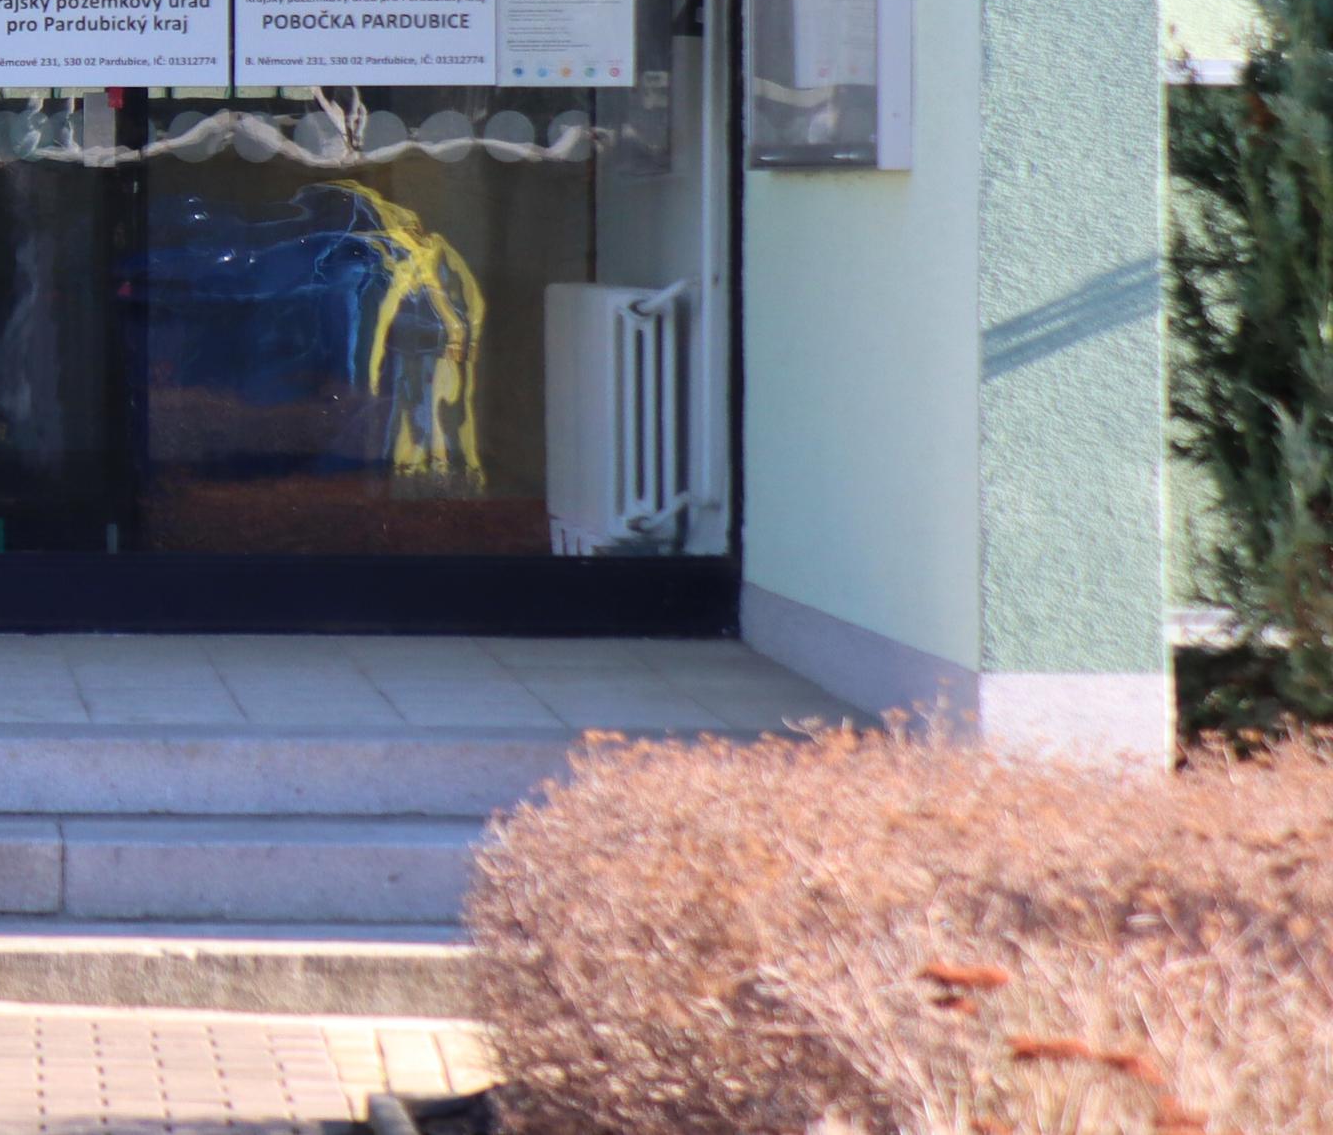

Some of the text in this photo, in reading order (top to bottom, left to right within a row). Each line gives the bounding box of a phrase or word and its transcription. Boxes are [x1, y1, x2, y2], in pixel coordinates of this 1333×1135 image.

[7, 15, 189, 35] pro Pardubický kraj
[262, 10, 470, 30] POBOČKA PARDUBICE
[40, 58, 60, 67] 231,
[64, 58, 82, 66] 530
[84, 58, 96, 66] 02
[99, 57, 150, 67] Pardubice,
[168, 57, 217, 66] 01312774
[257, 56, 303, 66] Němcové
[351, 57, 362, 65] 02
[365, 56, 417, 66] Pardubice,
[436, 56, 485, 65] 01312774
